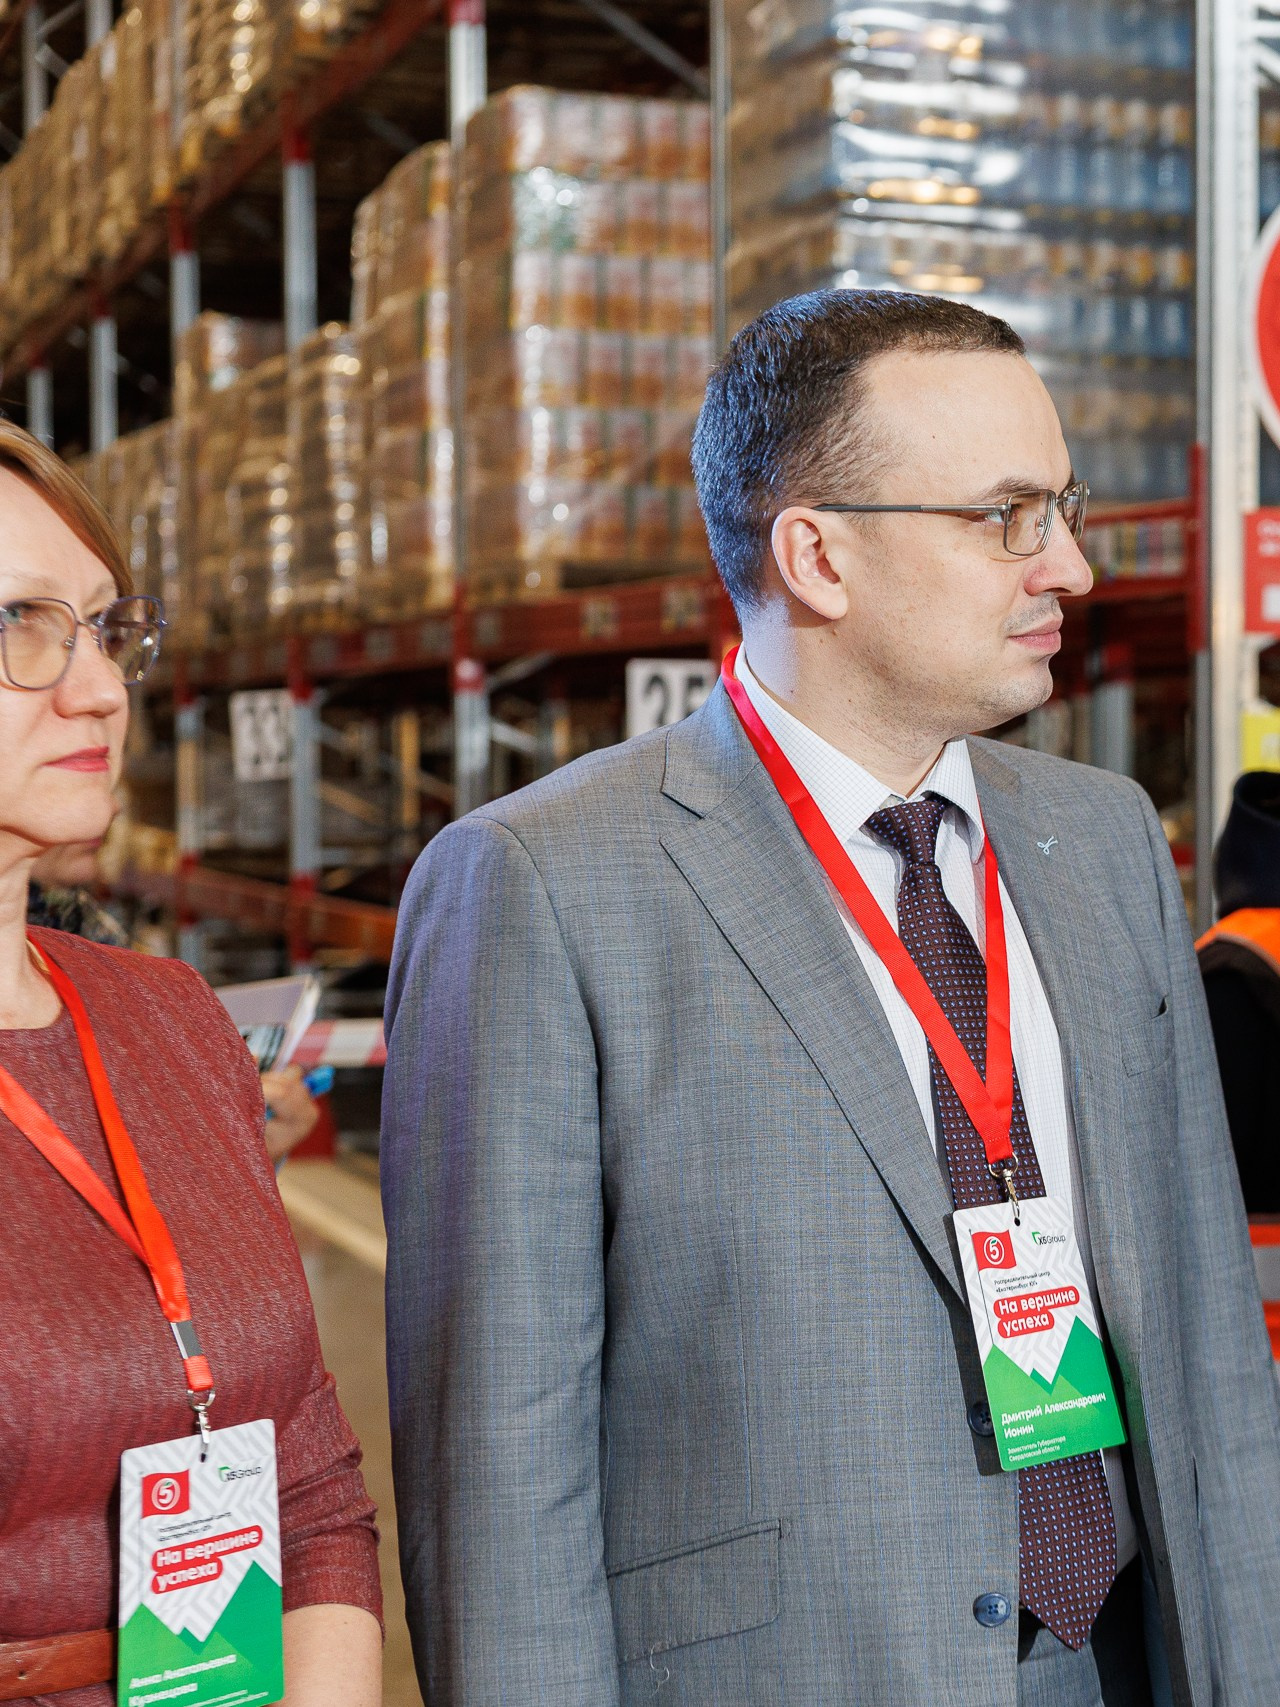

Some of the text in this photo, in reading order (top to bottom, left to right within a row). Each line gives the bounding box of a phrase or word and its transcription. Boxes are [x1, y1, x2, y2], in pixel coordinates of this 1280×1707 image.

[998, 1289, 1076, 1315] На вершине
[1003, 1313, 1050, 1336] успеха
[1001, 1392, 1107, 1426] Дмитрий Александрович
[1004, 1424, 1035, 1439] Ионин
[156, 1550, 182, 1567] На
[184, 1530, 260, 1560] вершине
[156, 1562, 218, 1591] успеха
